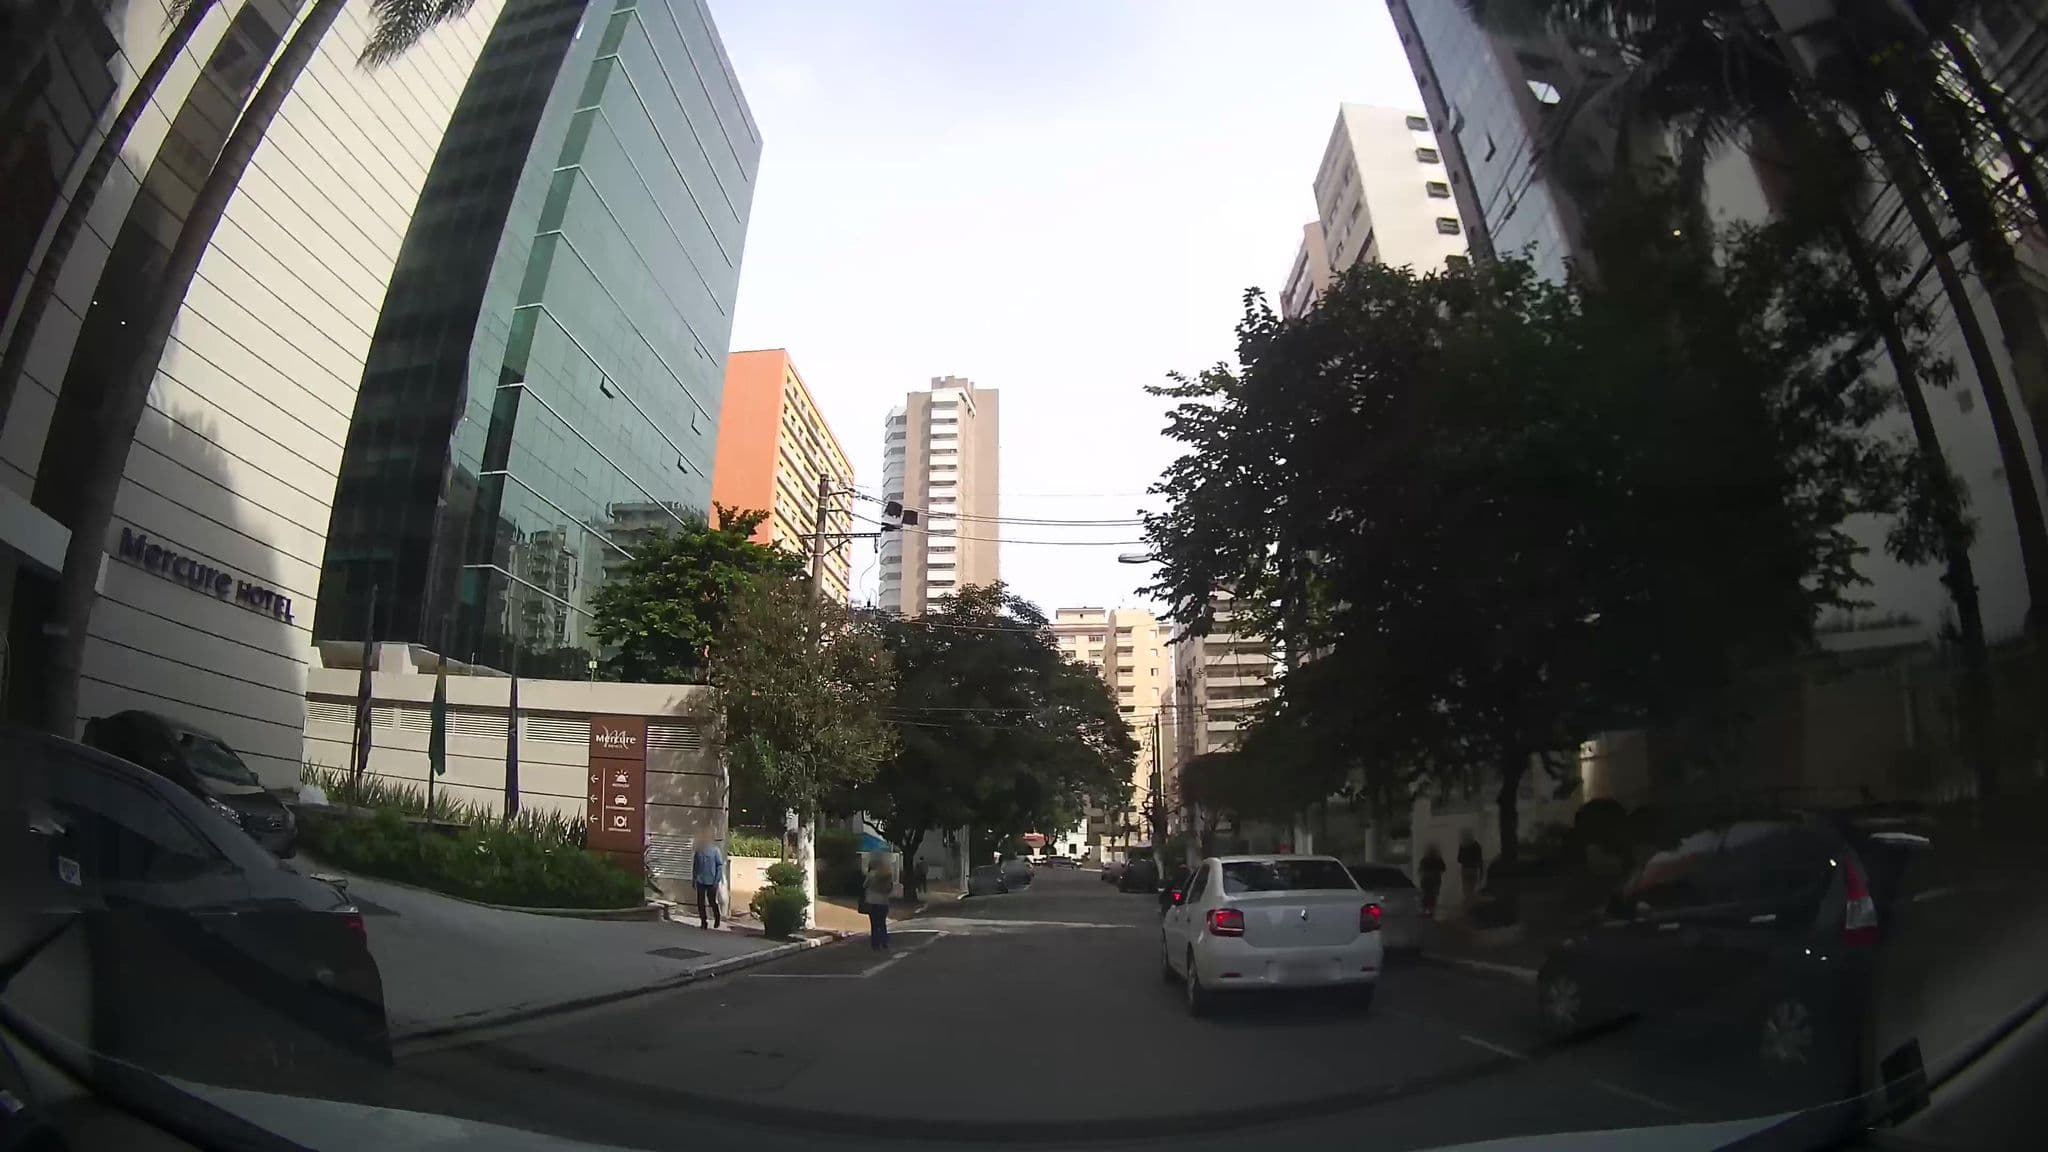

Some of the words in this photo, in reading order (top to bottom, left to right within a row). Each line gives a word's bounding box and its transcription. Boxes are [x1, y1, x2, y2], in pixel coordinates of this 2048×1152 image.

[119, 527, 232, 600] Mercure
[235, 580, 295, 625] HOTEL
[595, 733, 637, 745] Mercure
